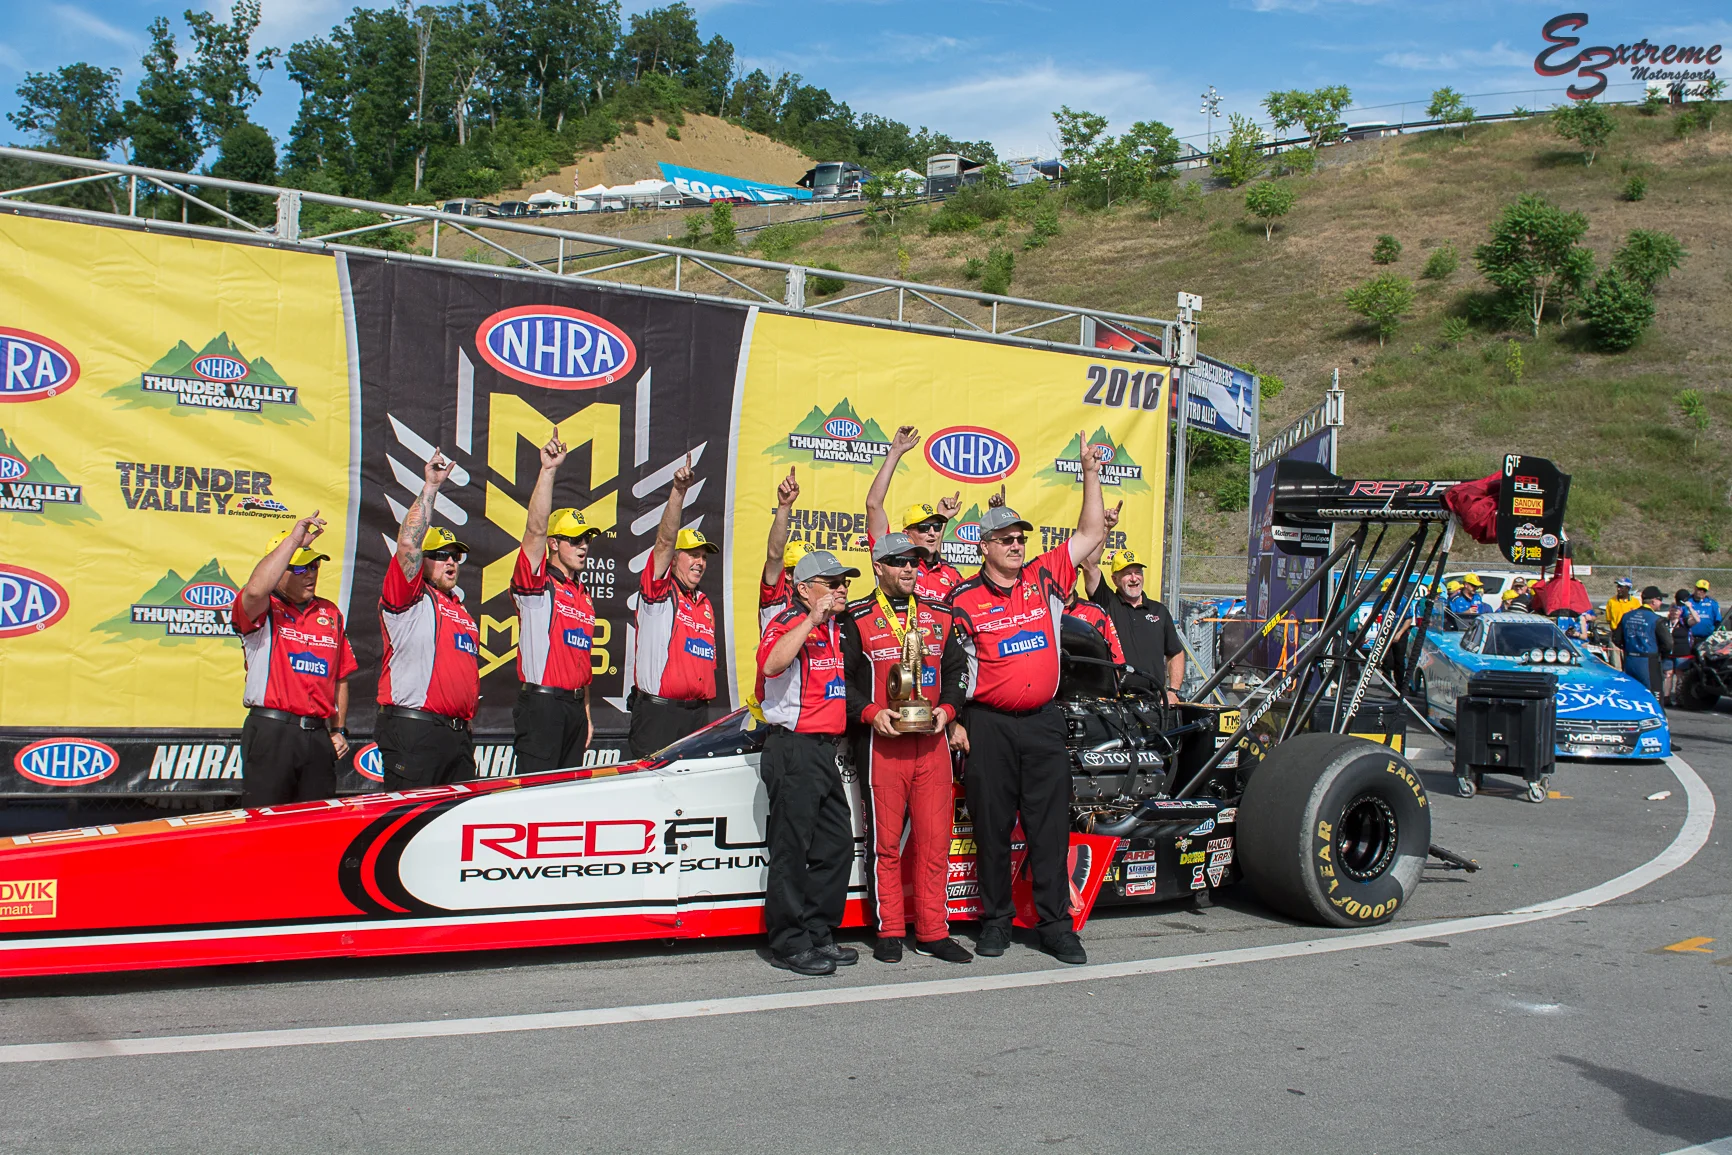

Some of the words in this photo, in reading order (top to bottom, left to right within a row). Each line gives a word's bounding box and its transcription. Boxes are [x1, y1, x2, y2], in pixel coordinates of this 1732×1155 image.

[502, 320, 615, 375] NHRA
[199, 357, 248, 379] NHRA
[143, 375, 226, 397] THUNDER
[233, 384, 295, 403] VALLEY
[1084, 364, 1164, 411] 2016
[178, 393, 260, 411] NATIONALS
[1201, 405, 1217, 425] ALLEY
[829, 420, 858, 436] NHRA
[790, 435, 848, 451] THUNDER
[815, 449, 872, 463] NATIONALS
[938, 437, 1008, 474] NHRA
[1505, 454, 1513, 476] 6
[1512, 455, 1522, 468] TF
[115, 462, 273, 496] THUNDER
[1105, 465, 1140, 478] VALLEY
[1515, 475, 1538, 483] RED
[9, 483, 79, 502] VALLEY
[1514, 482, 1541, 491] FUEL
[119, 487, 233, 515] VALLEY
[1514, 498, 1542, 508] SANDVIK
[227, 510, 297, 520] BristolDragway.com
[941, 542, 977, 556] UNDER
[587, 558, 616, 571] RAG
[580, 571, 615, 585] CING
[190, 586, 237, 607] NHRA
[133, 607, 216, 623] THUNDER
[169, 623, 236, 635] NATIONA
[1003, 635, 1045, 655] LOWE'S
[1349, 610, 1396, 717] TOYOTARACING.COM
[1246, 676, 1292, 730] GOODYEAR
[1569, 733, 1624, 743] MOPAR
[31, 745, 105, 777] NHRA
[1104, 752, 1160, 764] TOYTA
[1386, 760, 1427, 808] EAGLE
[1123, 851, 1154, 861] ARP
[459, 862, 625, 883] POWERED
[631, 861, 675, 875] BY
[679, 855, 770, 873] SCHUM
[1129, 865, 1155, 873] Strange
[1317, 820, 1398, 919] GOODYEAR
[0, 881, 53, 900] DVIK
